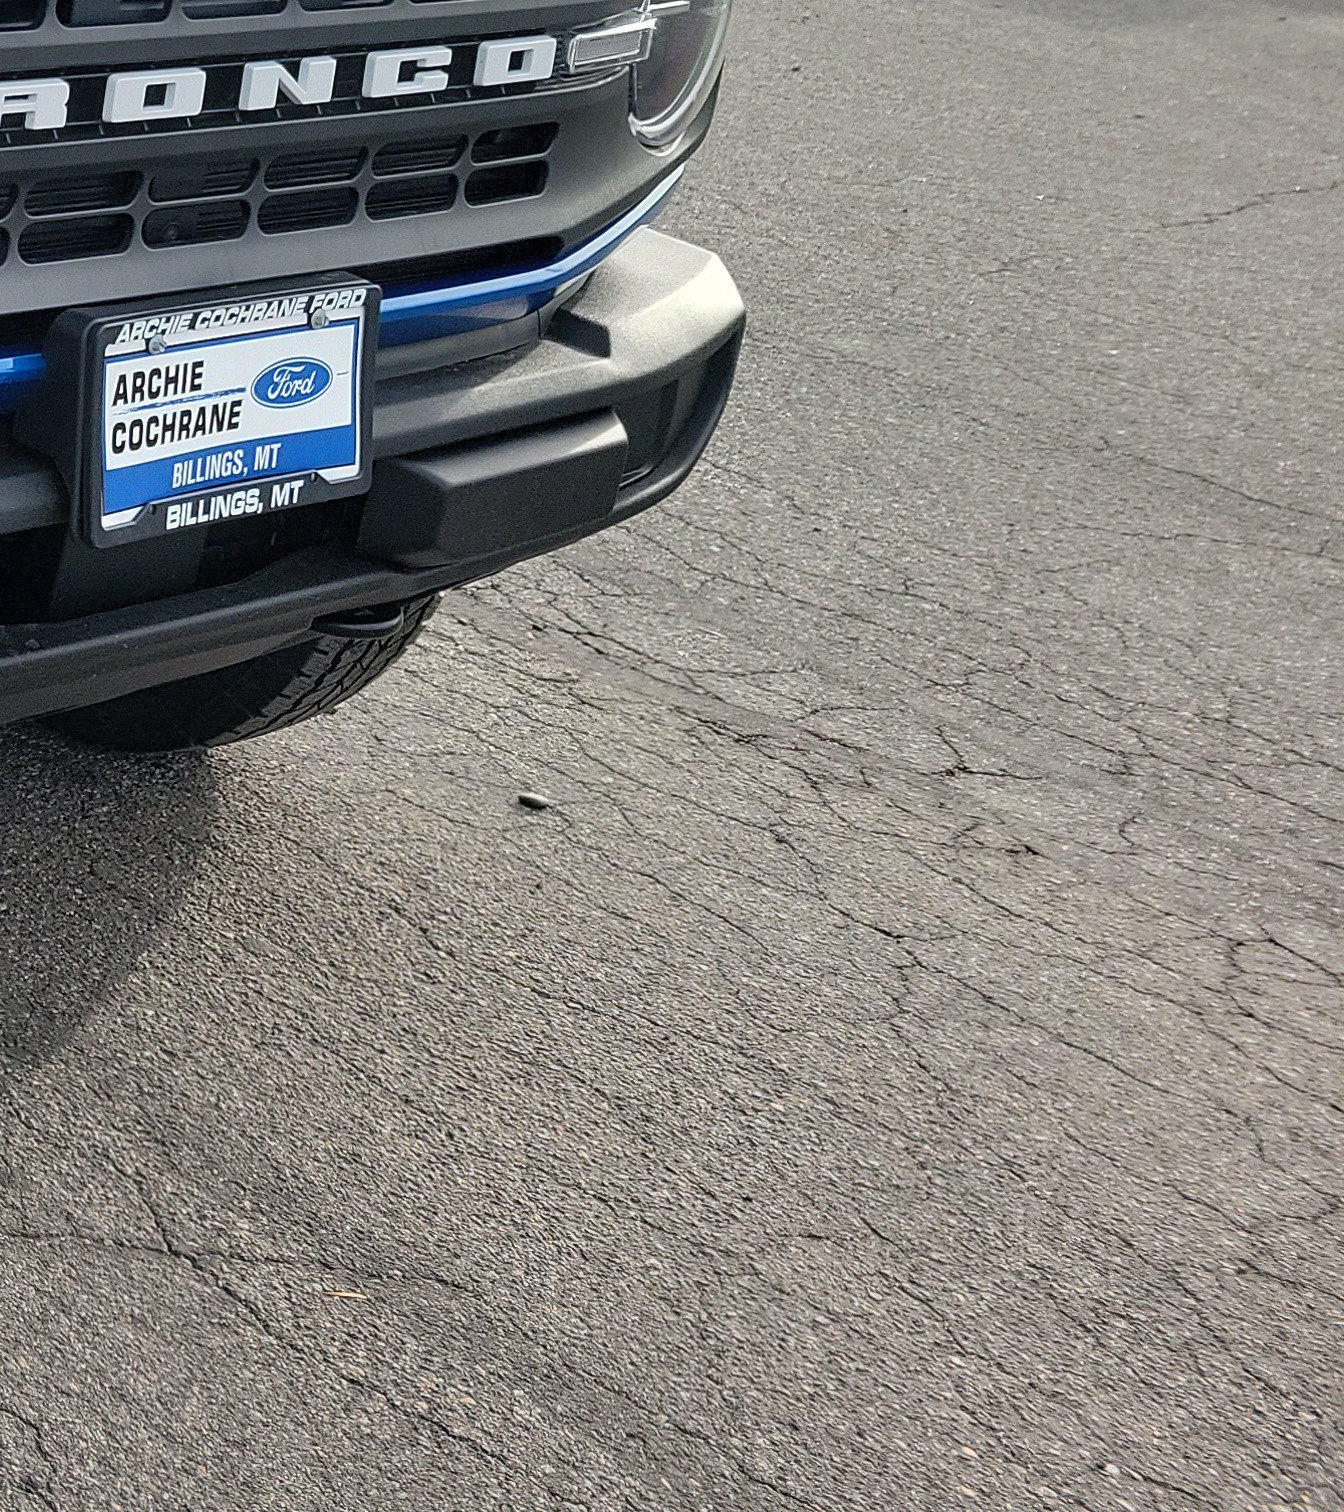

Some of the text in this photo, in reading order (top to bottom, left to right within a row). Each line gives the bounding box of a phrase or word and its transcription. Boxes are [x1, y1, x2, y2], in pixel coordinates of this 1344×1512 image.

[114, 288, 368, 345] ARCHIE COCHRANE FORD
[112, 359, 205, 407] ARCHIE
[266, 365, 316, 400] Ford
[110, 398, 243, 455] COCHRANE
[171, 443, 282, 489] BILLINGS, MT
[165, 480, 305, 532] BILLINGS, MT
